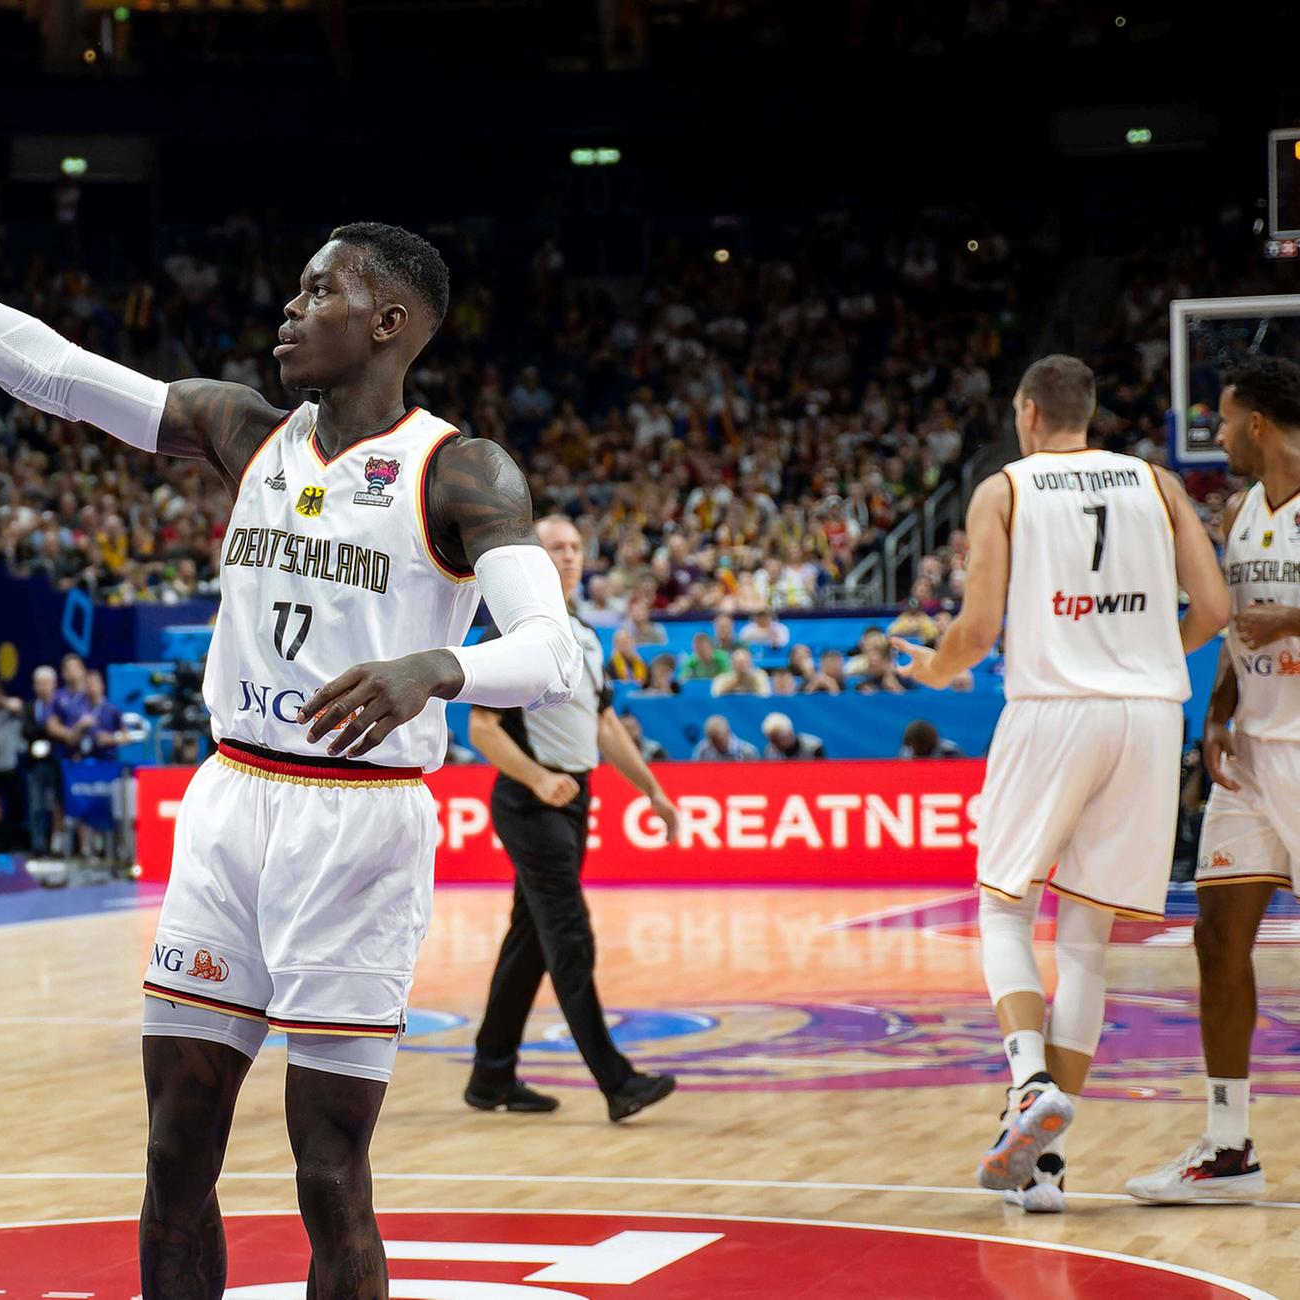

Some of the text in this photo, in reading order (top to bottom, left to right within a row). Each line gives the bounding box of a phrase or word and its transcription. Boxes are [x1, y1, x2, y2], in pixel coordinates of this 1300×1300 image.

[1033, 470, 1141, 492] VOIGTMANN
[225, 528, 390, 595] DEUTSCHLAND
[1083, 504, 1106, 571] 7
[1052, 591, 1147, 621] tipwin
[272, 602, 313, 661] 17
[238, 681, 306, 723] ING
